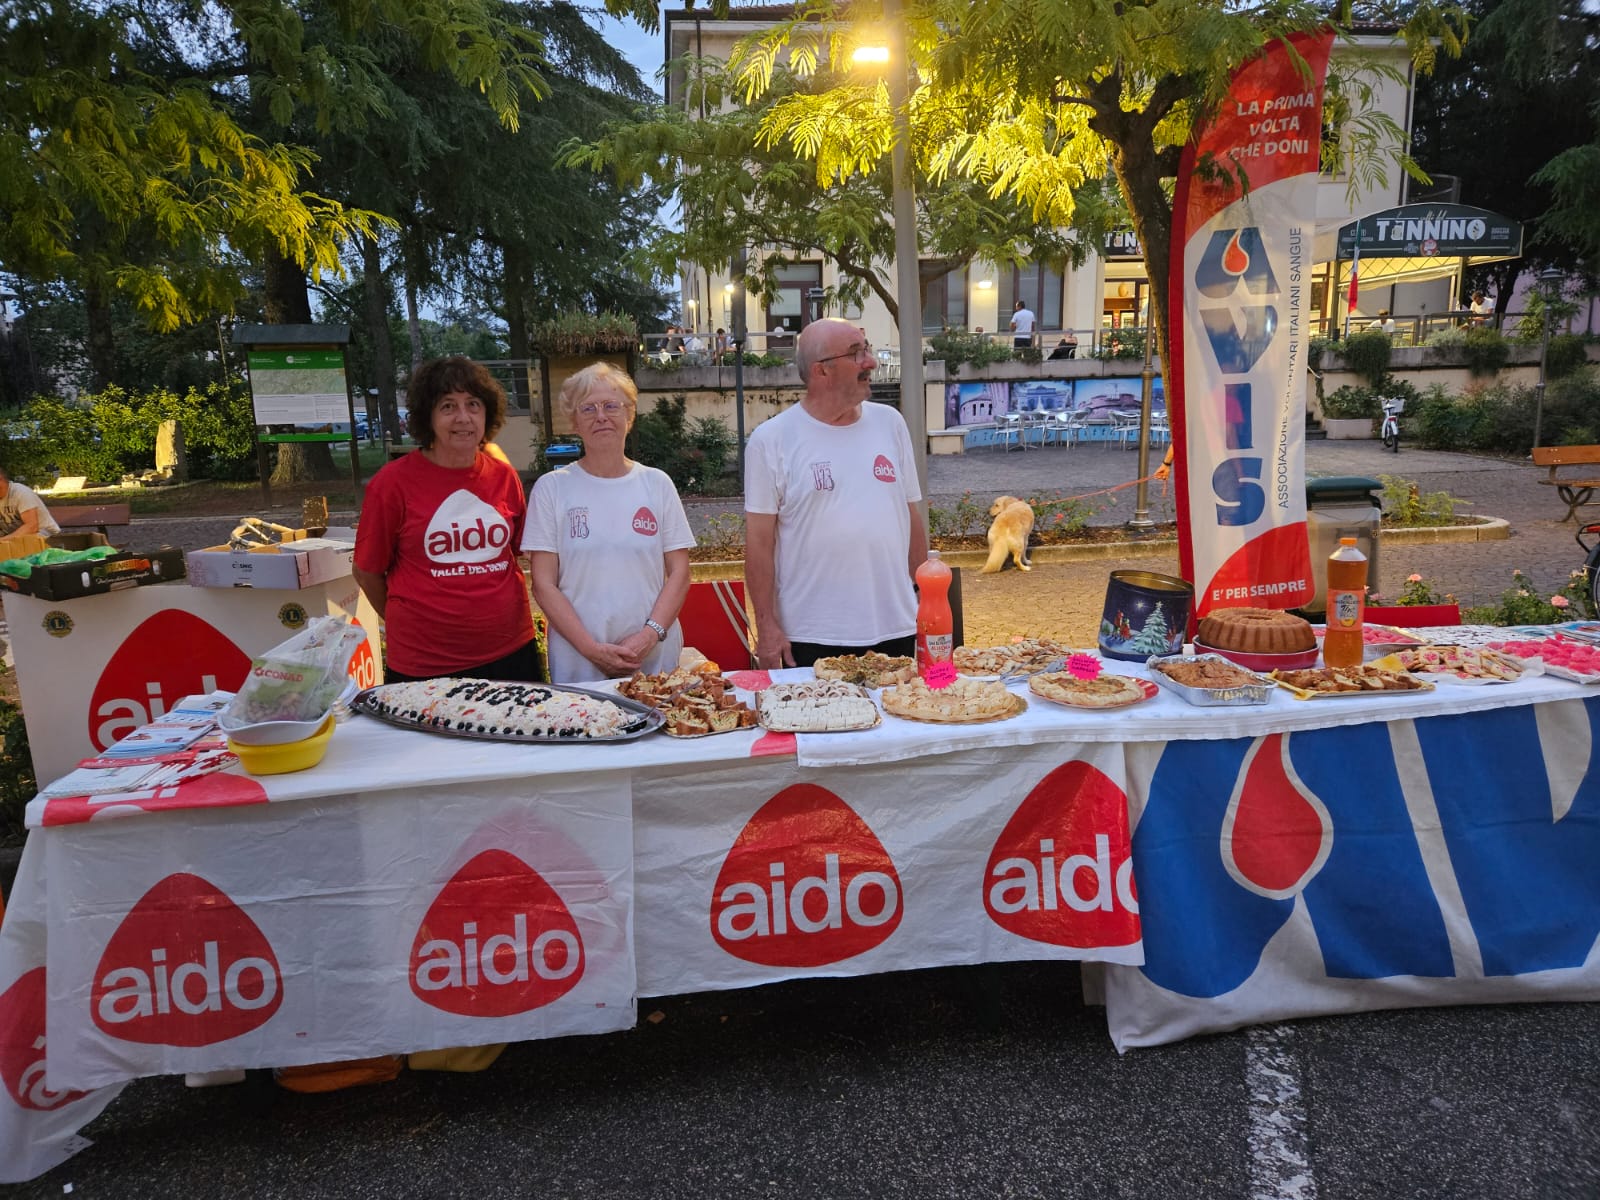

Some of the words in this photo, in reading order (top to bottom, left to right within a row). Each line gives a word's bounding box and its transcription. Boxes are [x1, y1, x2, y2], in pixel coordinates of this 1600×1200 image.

[1236, 99, 1260, 117] LA
[1262, 91, 1315, 115] PRIMA
[1249, 115, 1300, 137] VOLTA
[1230, 141, 1261, 160] CHE
[1263, 138, 1309, 156] DONI
[1289, 227, 1302, 282] SANGUE
[1289, 287, 1301, 336] ITALIANI
[1194, 226, 1281, 527] AVIS
[1278, 415, 1289, 509] ASSOCIAZIONE
[428, 517, 509, 556] aido
[633, 516, 657, 532] aido
[430, 565, 466, 578] VALLE
[467, 564, 488, 575] DEL
[1212, 589, 1224, 601] E'
[1226, 587, 1248, 600] PER
[1250, 579, 1306, 597] SEMPRE
[264, 669, 304, 683] CONAD
[350, 650, 374, 690] ido
[716, 853, 899, 942] aido
[414, 913, 581, 991] aido
[98, 941, 278, 1024] aido
